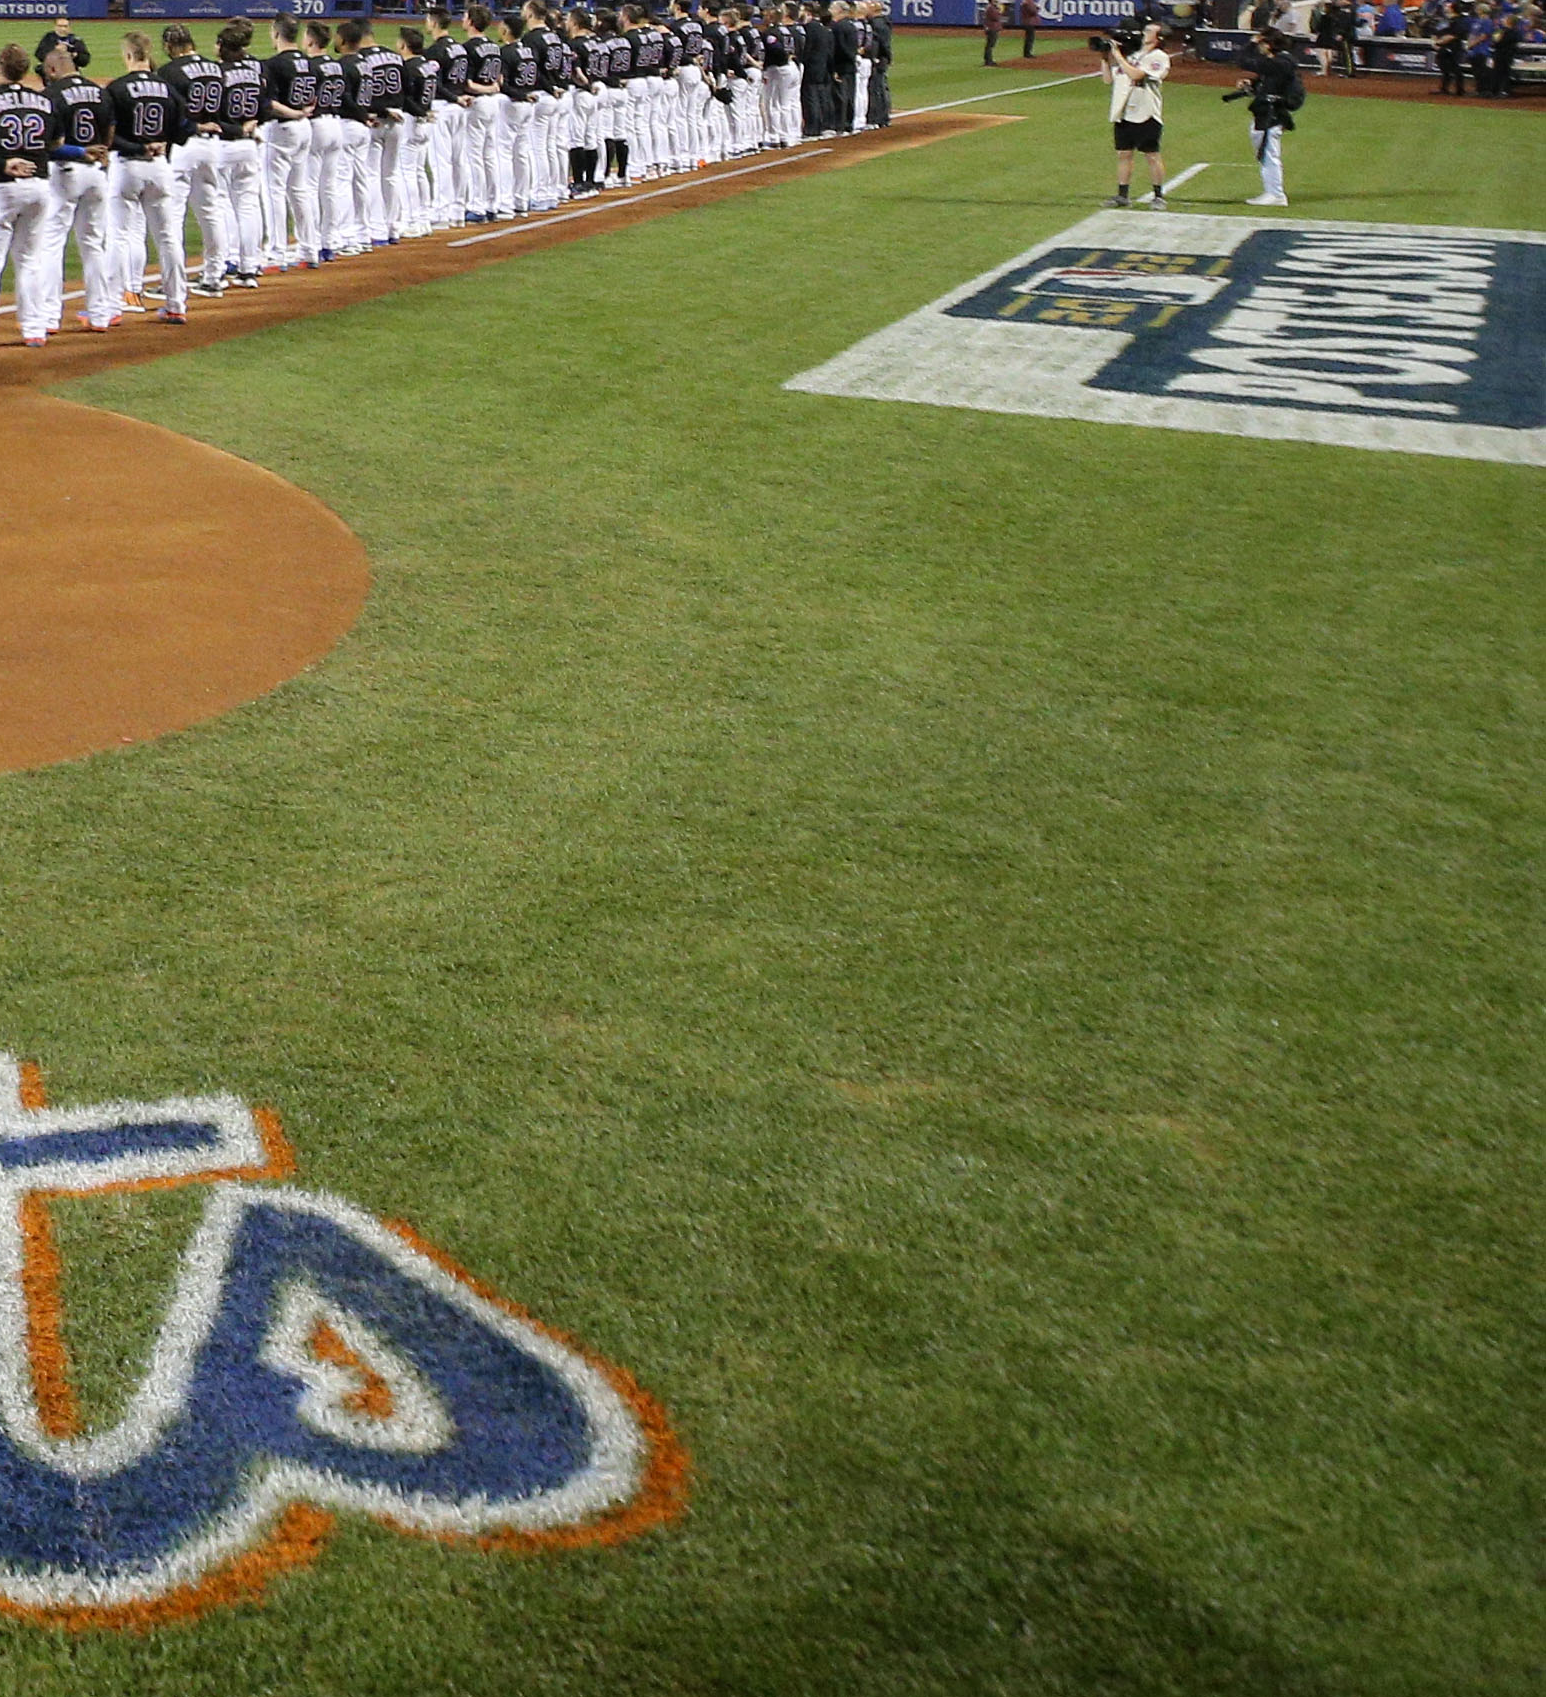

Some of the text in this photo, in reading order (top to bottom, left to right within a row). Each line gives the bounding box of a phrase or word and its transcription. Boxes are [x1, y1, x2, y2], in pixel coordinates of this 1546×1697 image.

[292, 0, 324, 15] 370
[188, 81, 223, 113] 99
[289, 76, 317, 106] 65
[319, 79, 345, 108] 62
[372, 67, 402, 96] 59
[228, 88, 260, 118] 85
[0, 113, 45, 150] 32
[73, 108, 95, 143] 6
[134, 102, 164, 136] 19
[1163, 231, 1498, 416] POSTSEASON
